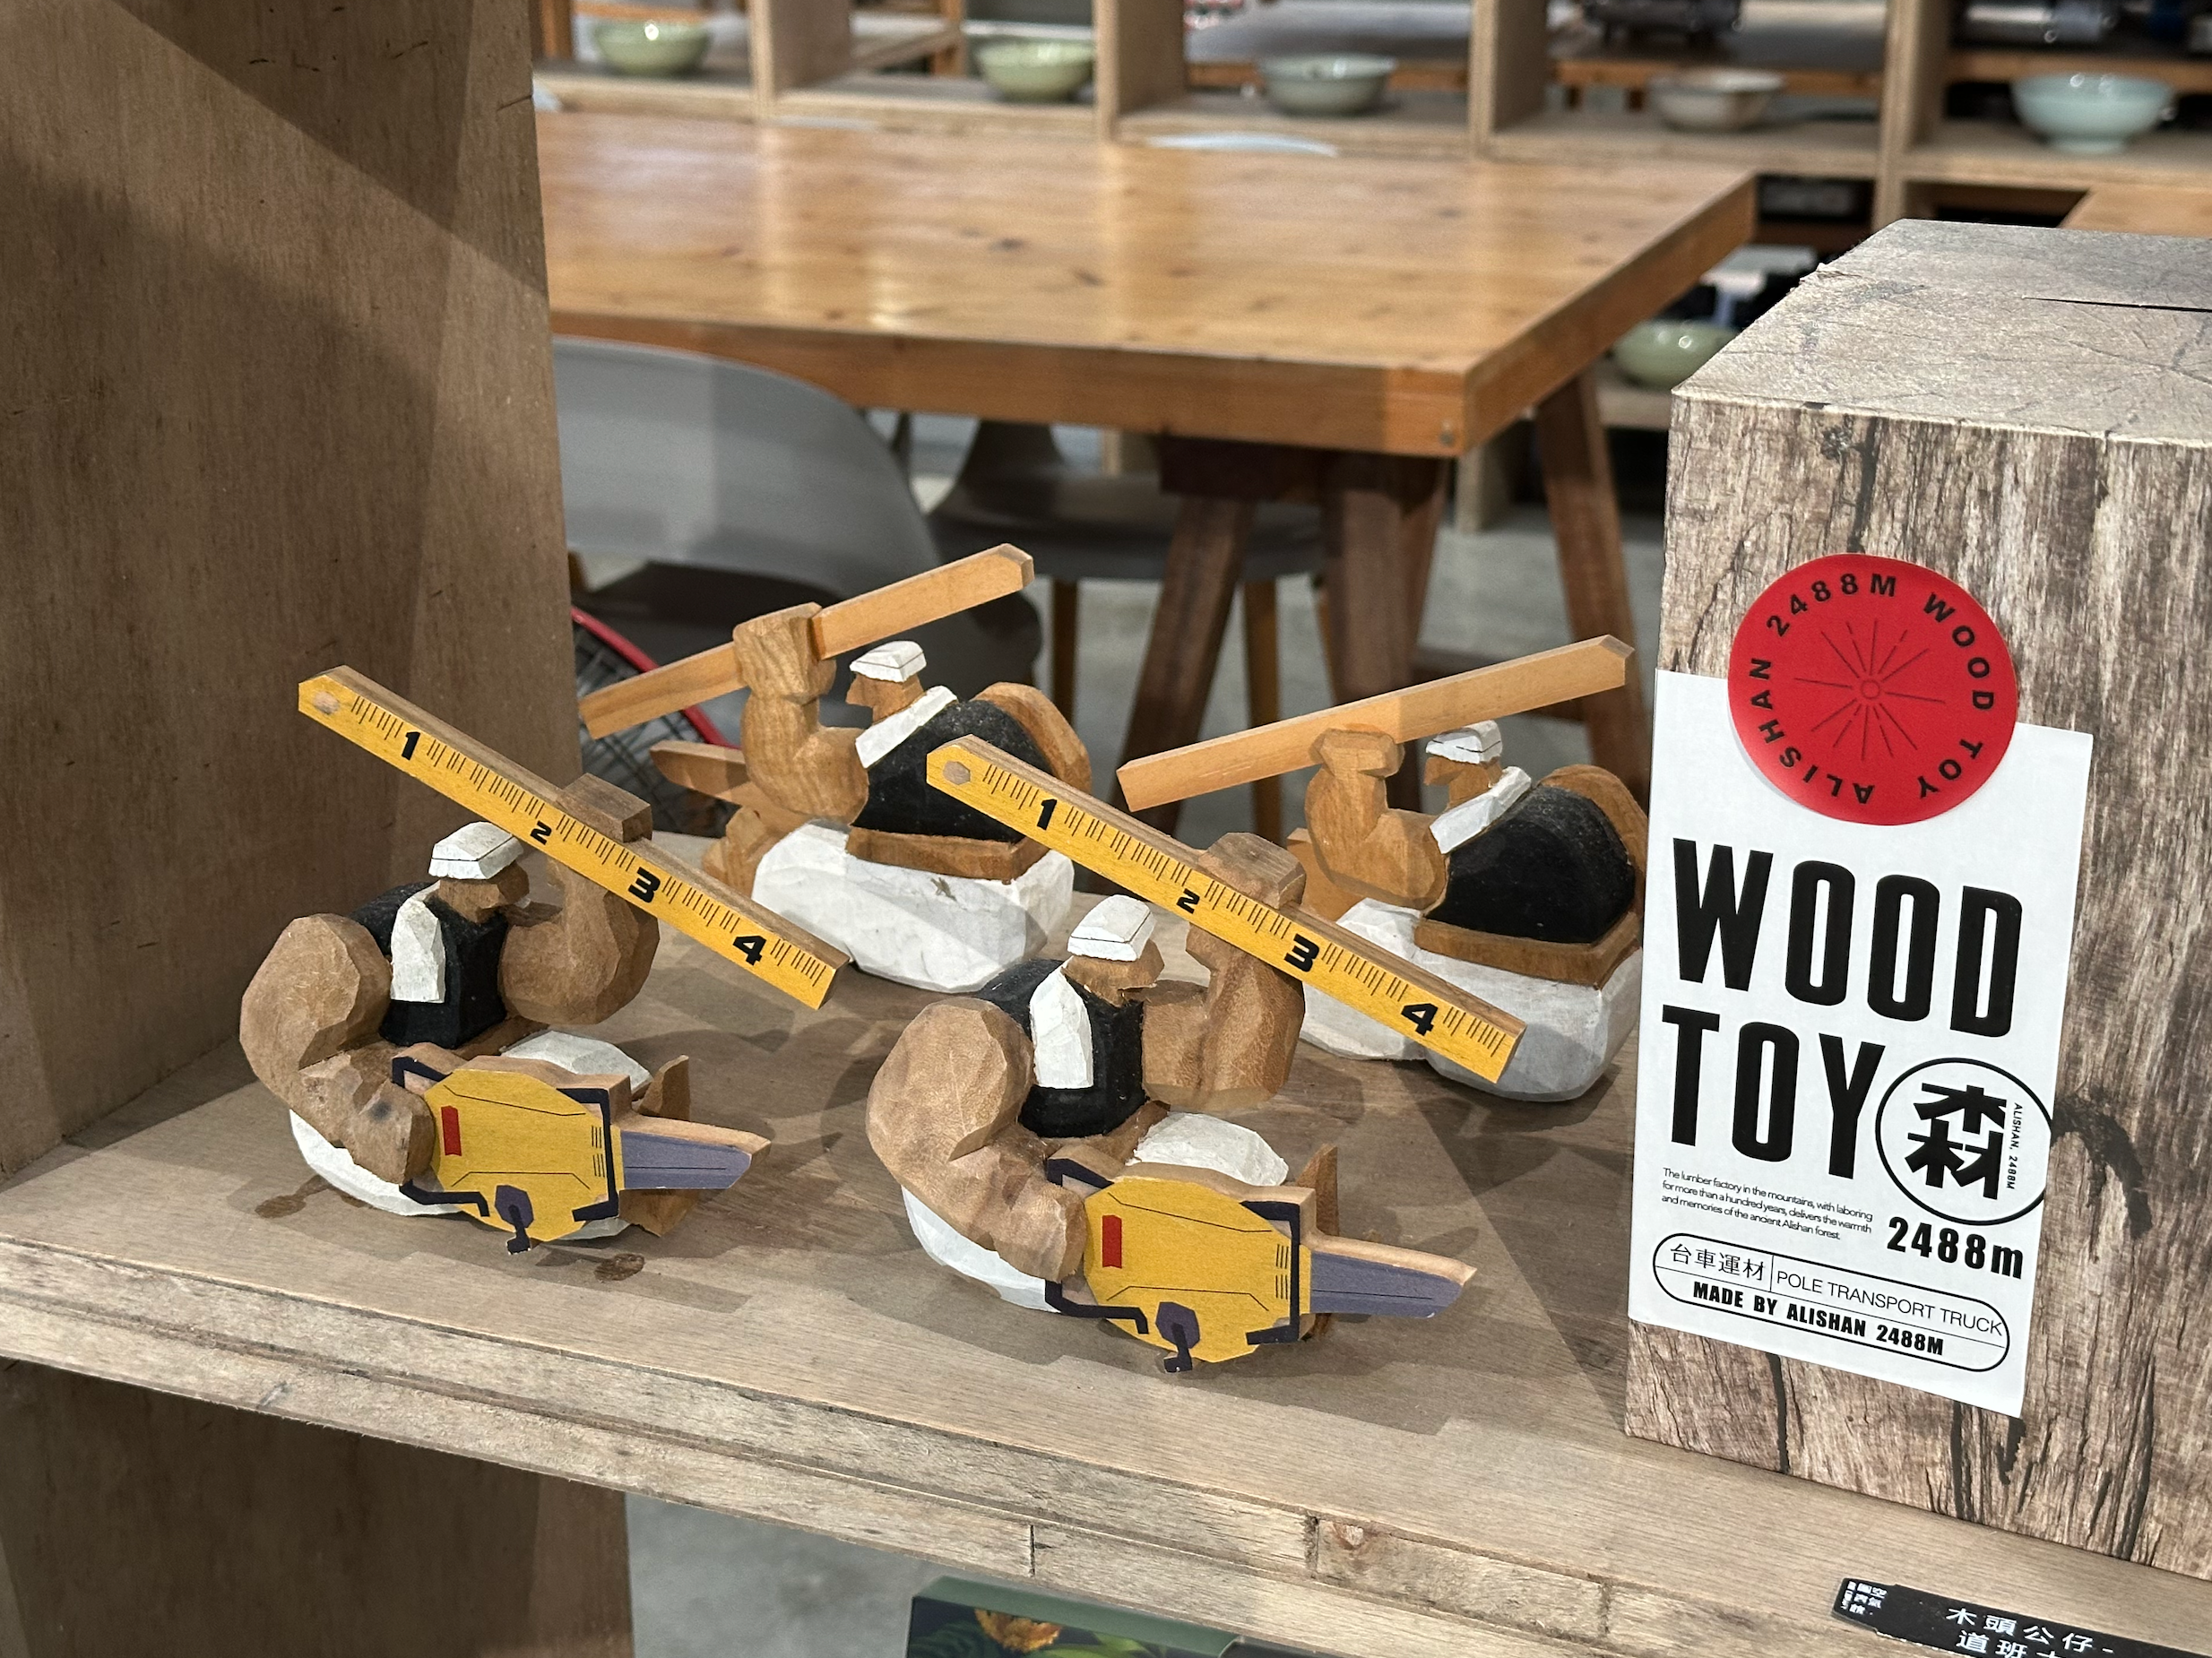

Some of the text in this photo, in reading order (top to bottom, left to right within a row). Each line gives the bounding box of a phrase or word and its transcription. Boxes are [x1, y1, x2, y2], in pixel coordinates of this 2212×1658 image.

[1750, 573, 1994, 804] ALISHAN 2488M WOOD TOY
[401, 731, 767, 966] 1 2 3 4
[1036, 799, 1439, 1036] 1 2 3 4
[1672, 837, 2023, 1038] WOOD
[1662, 1004, 1887, 1180] TOY
[2006, 1101, 2024, 1190] ALISHAN, 2488M
[1662, 1196, 1841, 1239] and memories of the ancient Alishan forest.
[1663, 1167, 1873, 1222] The lumber factory in the mountains, with laboring
[1663, 1179, 1674, 1190] for
[1674, 1185, 1698, 1196] more
[1699, 1187, 1718, 1200] than
[1725, 1193, 1763, 1209] hundred
[1763, 1204, 1787, 1216] years,
[1789, 1207, 1822, 1223] delivers
[1822, 1214, 1837, 1225] the
[1837, 1220, 1872, 1233] warmth
[1670, 1243, 1766, 1281] 台車運材
[1887, 1216, 2024, 1279] 2488m
[1693, 1281, 1944, 1356] MADE BY ALISHAN 2488M
[1776, 1270, 2003, 1336] POLE TRANSPORT TRUCK
